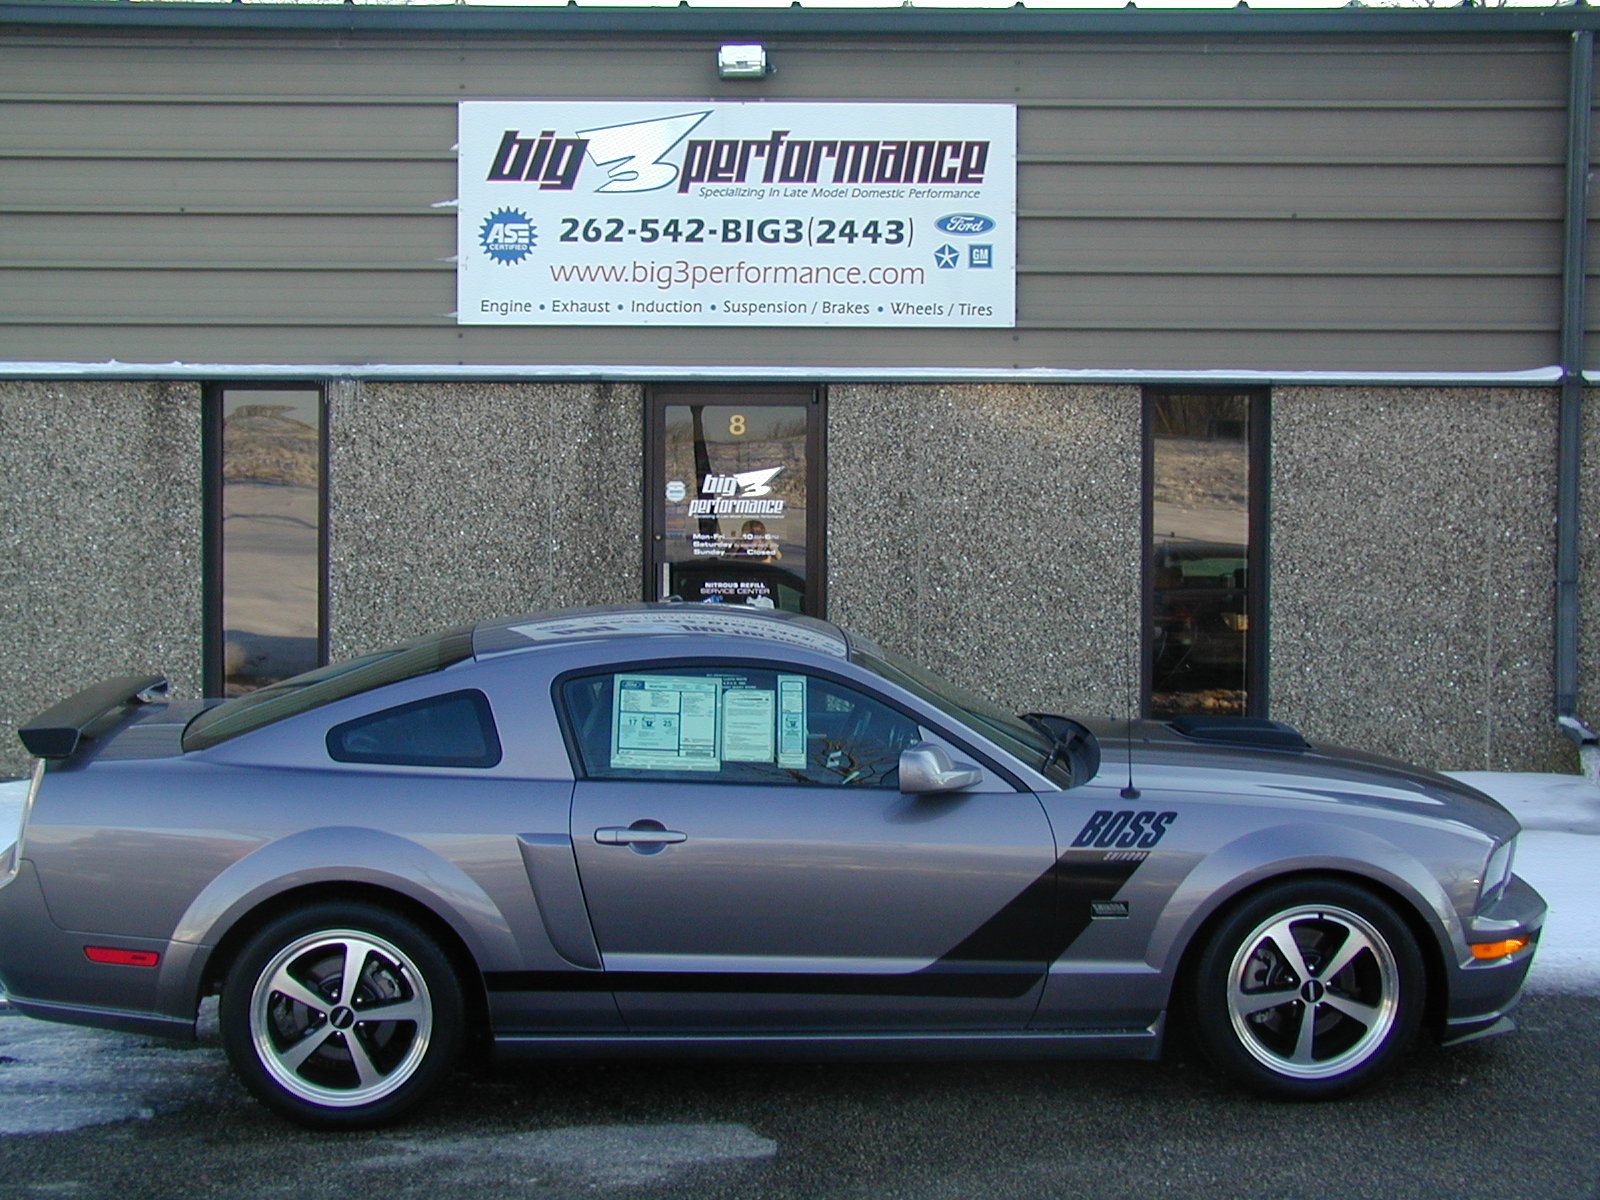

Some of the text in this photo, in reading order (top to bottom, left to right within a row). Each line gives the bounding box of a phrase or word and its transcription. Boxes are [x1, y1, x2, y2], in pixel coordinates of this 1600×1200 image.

[487, 130, 590, 190] big
[677, 130, 991, 193] performance
[699, 186, 981, 199] Specializing In Late Model Domestic Performance
[486, 223, 530, 243] ASE
[946, 215, 984, 232] Ford
[489, 243, 528, 251] CERTIFIED
[973, 248, 989, 261] GM
[550, 260, 925, 290] www.big3performance.com
[480, 300, 532, 315] Engine
[552, 300, 610, 313] Exhaust
[631, 300, 702, 313] Induction
[723, 300, 807, 318] Suspension
[822, 301, 870, 314] Brakes
[890, 302, 944, 316] Wheels
[958, 303, 993, 316] Tires
[729, 414, 746, 435] 8
[702, 473, 739, 496] big
[688, 497, 784, 517] performance
[1070, 810, 1178, 848] BOSS
